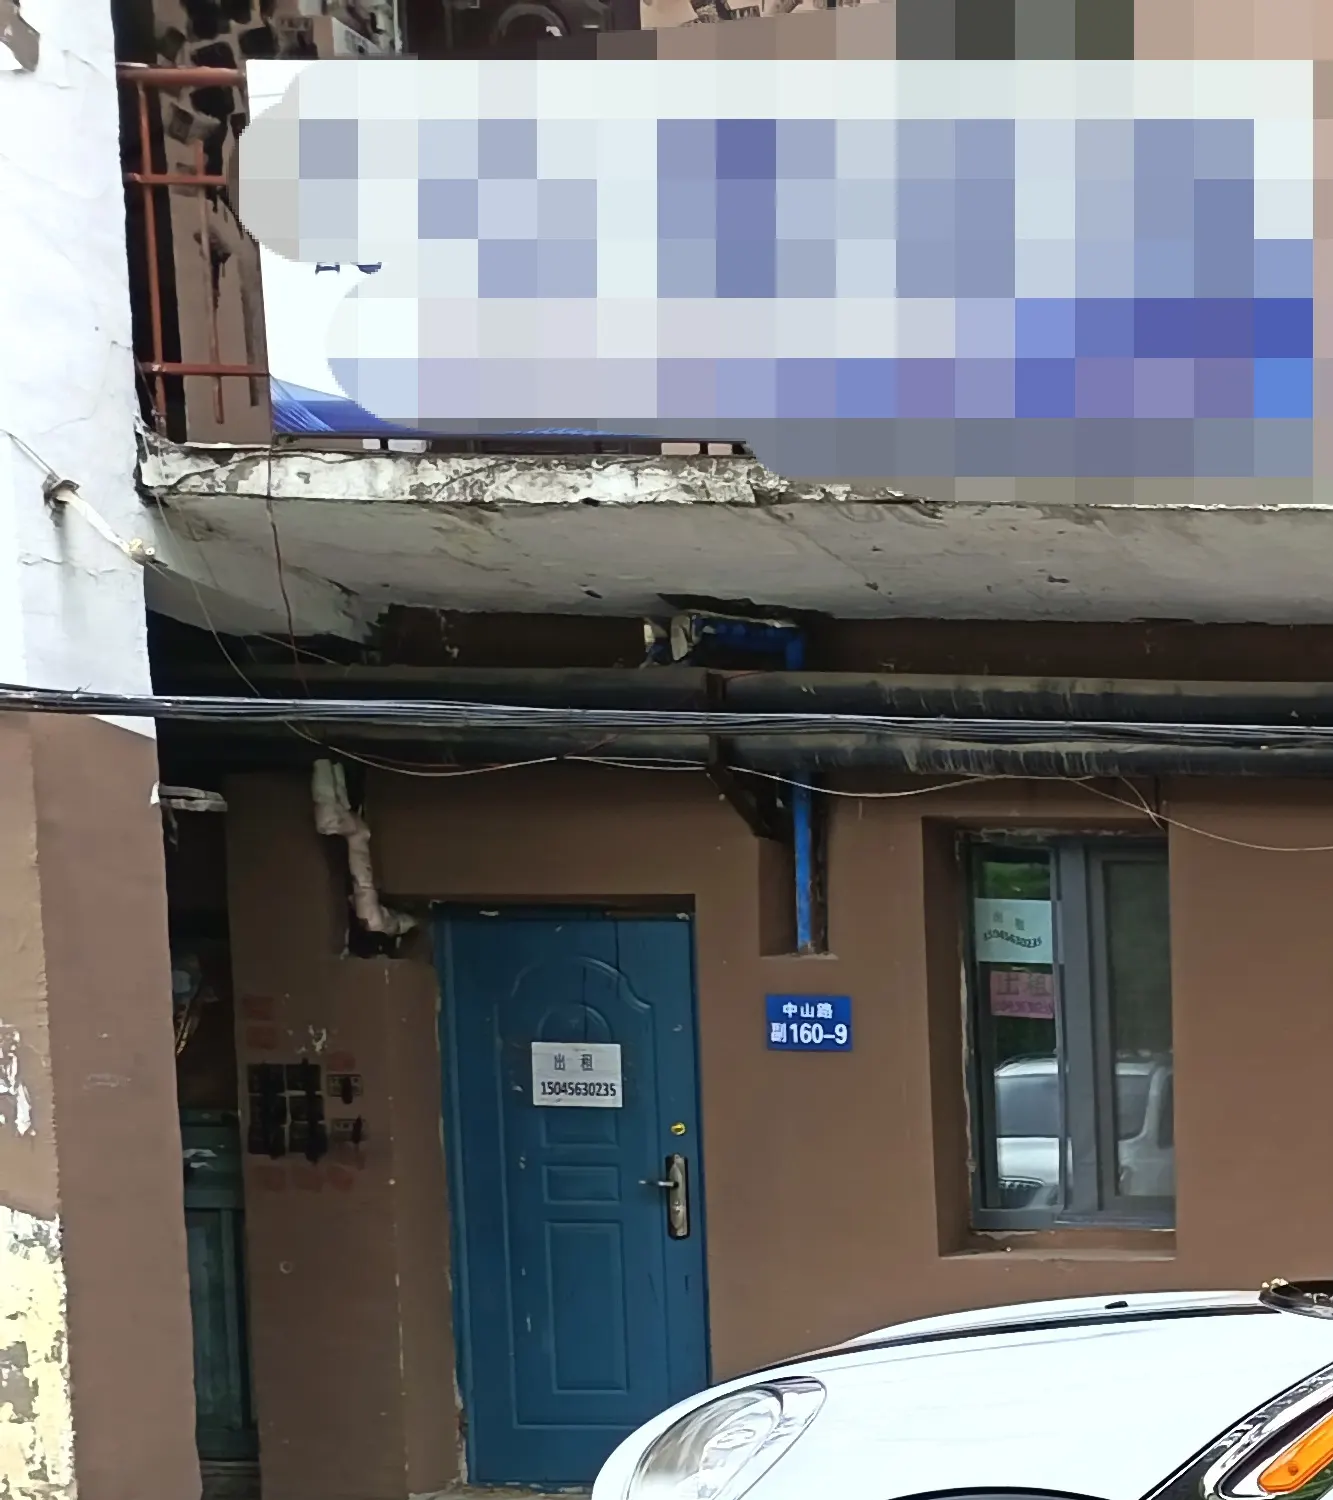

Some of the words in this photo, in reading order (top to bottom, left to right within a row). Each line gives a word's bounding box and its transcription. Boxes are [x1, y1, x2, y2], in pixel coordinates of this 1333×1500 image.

[782, 1002, 833, 1019] 中山路
[553, 1053, 594, 1072] 出租
[540, 1081, 617, 1097] 15045630235
